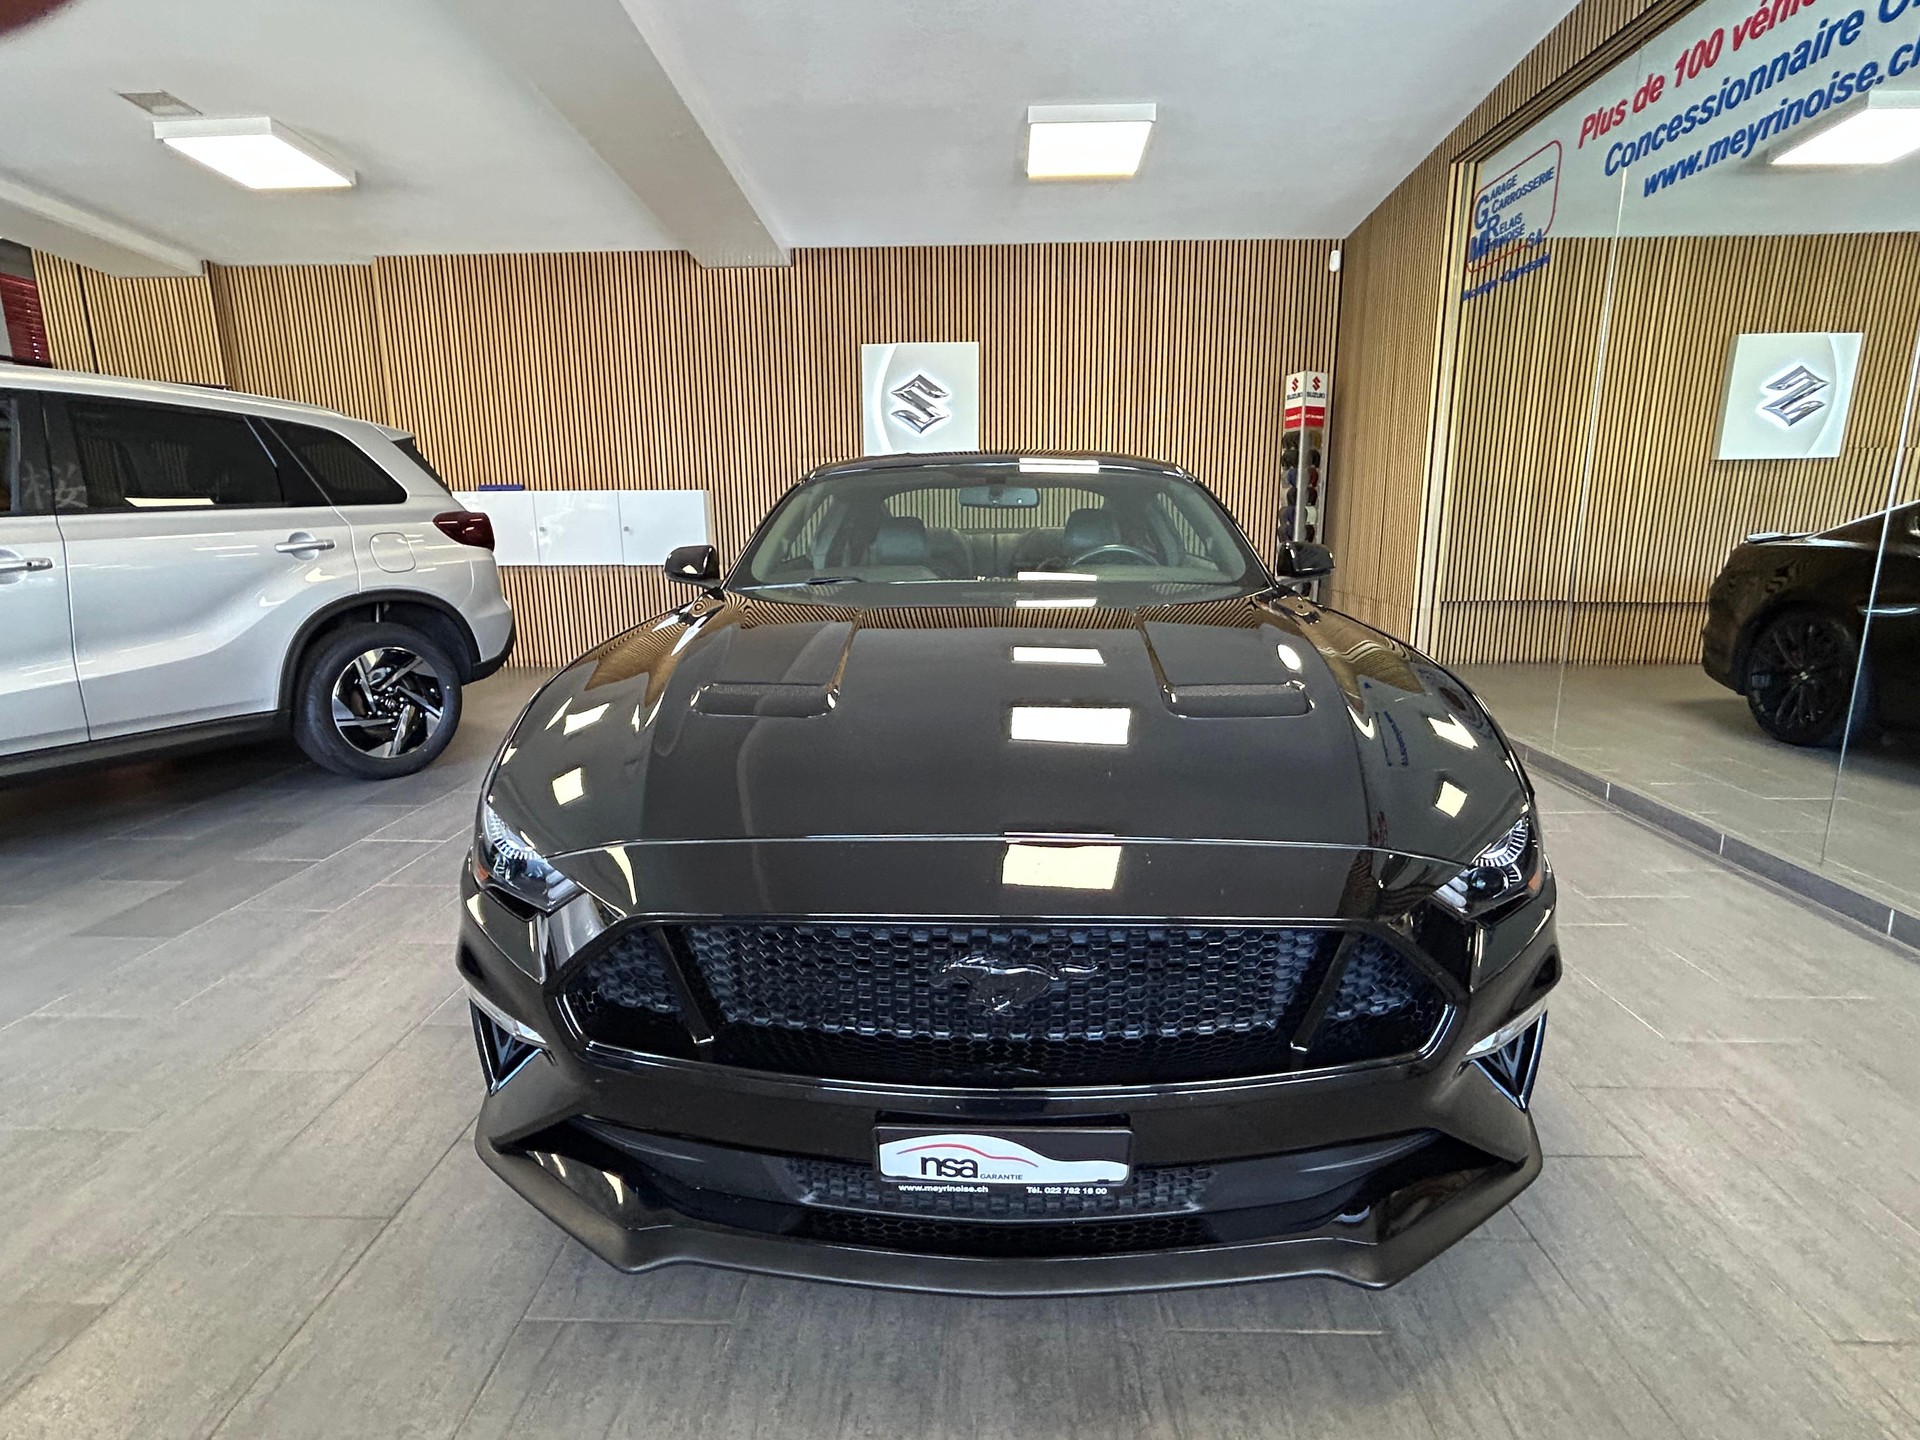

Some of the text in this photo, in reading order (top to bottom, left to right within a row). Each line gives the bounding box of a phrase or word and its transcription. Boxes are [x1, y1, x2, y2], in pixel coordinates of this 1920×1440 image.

[1578, 0, 1816, 149] Plus de 100 véh
[1604, 10, 1865, 177] Concessionnaire
[1491, 166, 1555, 214] CARROSSERIE
[1527, 228, 1543, 249] SA
[920, 1156, 1023, 1181] nsa GARANTIE
[898, 1184, 989, 1193] www.meyrinoise.ch
[1026, 1186, 1042, 1194] Tél.
[1044, 1187, 1061, 1195] 022
[1095, 1187, 1107, 1195] 00
